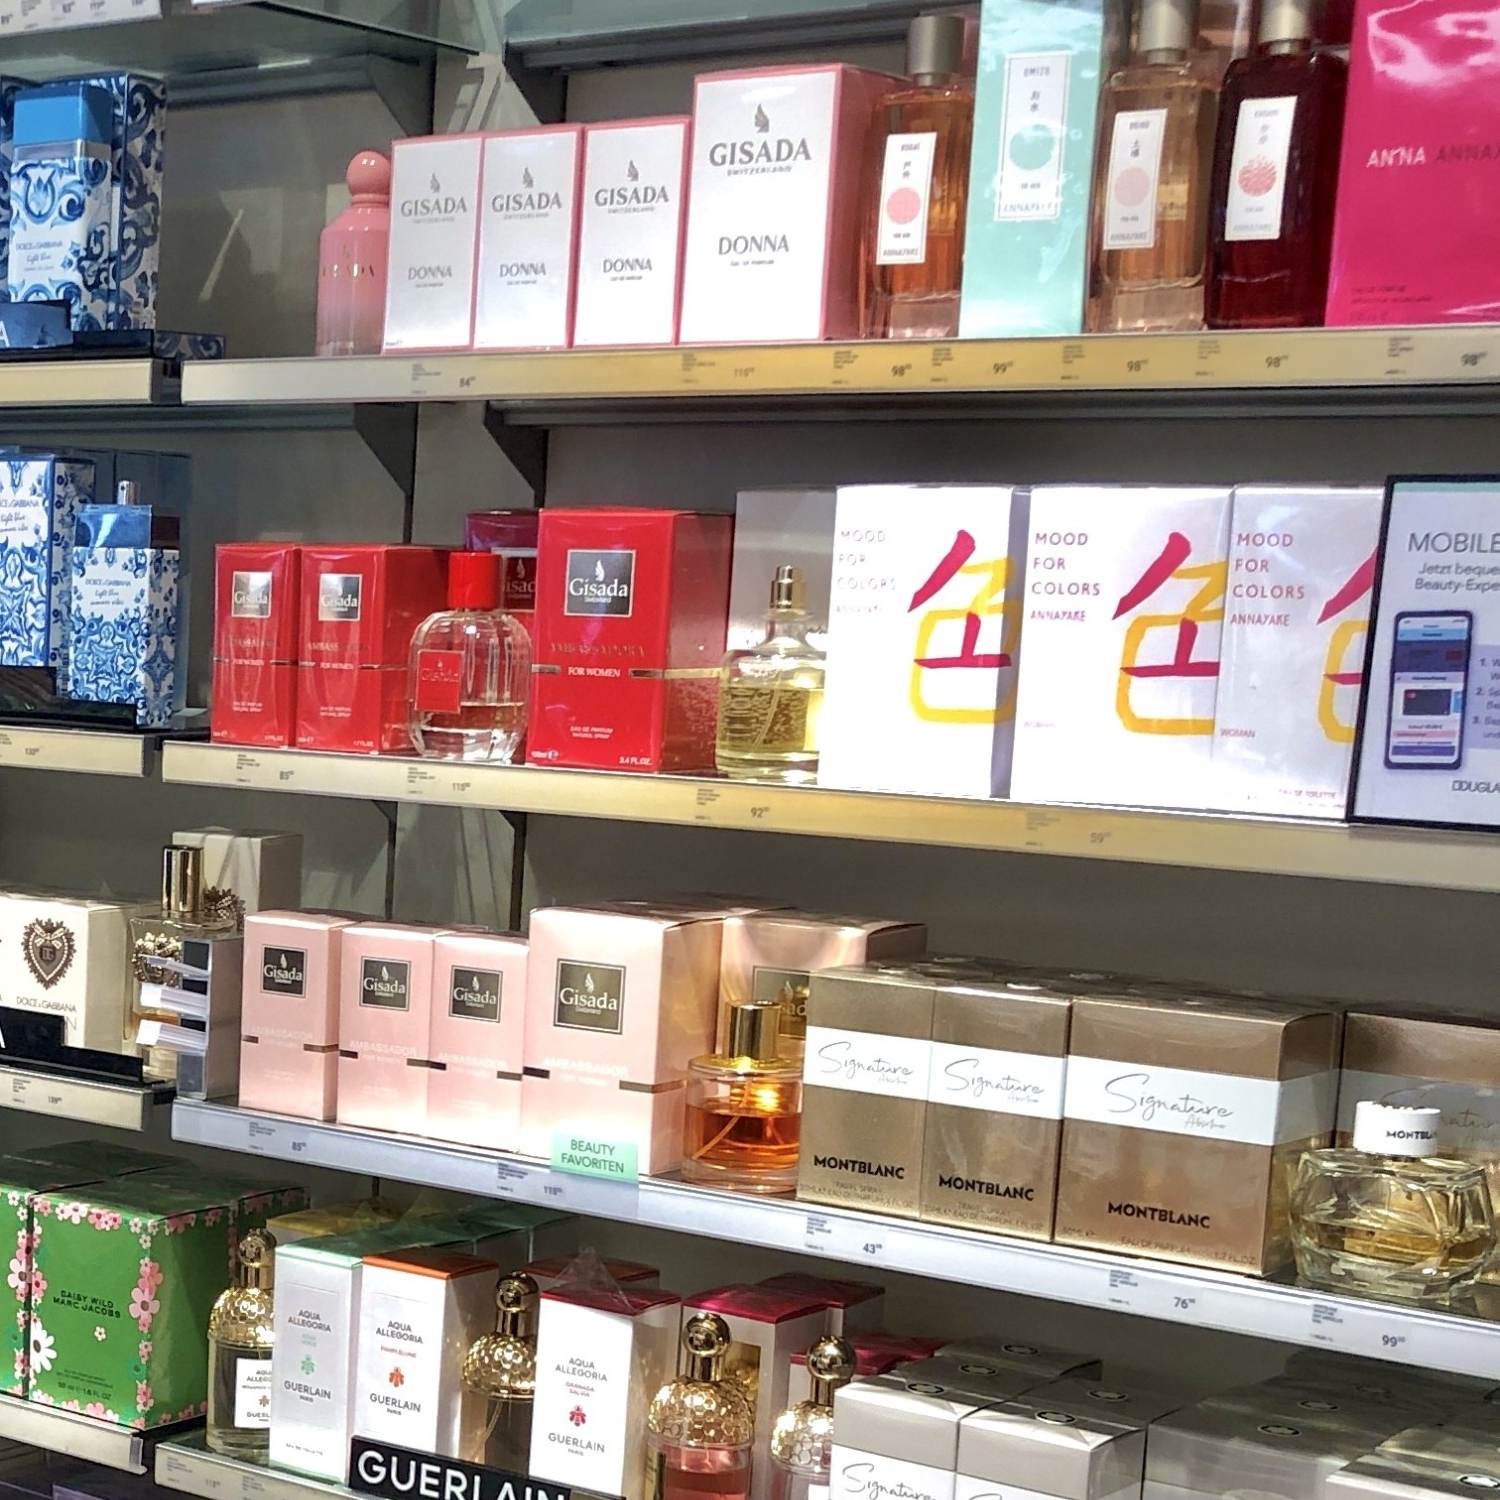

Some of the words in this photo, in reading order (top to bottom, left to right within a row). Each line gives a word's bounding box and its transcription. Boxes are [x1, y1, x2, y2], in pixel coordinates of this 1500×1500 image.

[709, 137, 812, 167] GISADA
[491, 192, 562, 214] GISADA
[594, 185, 669, 208] GISADA
[401, 197, 467, 219] GISADA
[718, 234, 790, 255] DONNA
[407, 264, 453, 280] DONNA
[499, 262, 546, 278] DONNA
[602, 258, 653, 274] DONNA
[1035, 532, 1088, 546] MOOD
[1237, 532, 1293, 548] MOOD
[1034, 557, 1066, 571] FOR
[1235, 559, 1269, 573] FOR
[569, 578, 629, 599] Gisada
[1031, 582, 1100, 597] COLORS
[1233, 585, 1305, 599] COLORS
[1030, 609, 1086, 623] ANNAYAKE
[1230, 614, 1289, 627] ANNAYAKE
[568, 667, 584, 677] FOR
[586, 668, 620, 678] WOMEN
[1220, 728, 1255, 739] WOMAN
[263, 962, 303, 982] Gisada
[363, 977, 407, 994] Gisada
[453, 986, 496, 1005] Gisada
[559, 987, 618, 1011] Gisada
[818, 1041, 913, 1081] Signature
[945, 1059, 1045, 1101] Signature
[1105, 1074, 1233, 1121] Signature
[1386, 1129, 1437, 1141] MONTBLA
[570, 1139, 615, 1157] BEAUTY
[561, 1153, 624, 1173] FAVORITEN
[814, 1154, 905, 1180] MONTBLANC
[939, 1173, 1034, 1202] MONTBLANC
[1108, 1201, 1210, 1230] MONTBLANC
[53, 1297, 78, 1309] MARC
[82, 1303, 121, 1319] JACOBS
[61, 1290, 85, 1302] DAISY
[89, 1298, 114, 1309] WILD
[287, 1316, 331, 1333] ALLEGORIA
[298, 1309, 321, 1323] AQUA
[375, 1325, 423, 1344] ALLEGORIA
[388, 1320, 412, 1334] AQUA
[555, 1361, 607, 1382] ALLEGORIA
[568, 1357, 594, 1372] AQUA
[284, 1380, 331, 1400] GUERLAIN
[370, 1392, 421, 1412] GUERLAIN
[548, 1432, 605, 1453] GUERLAIN
